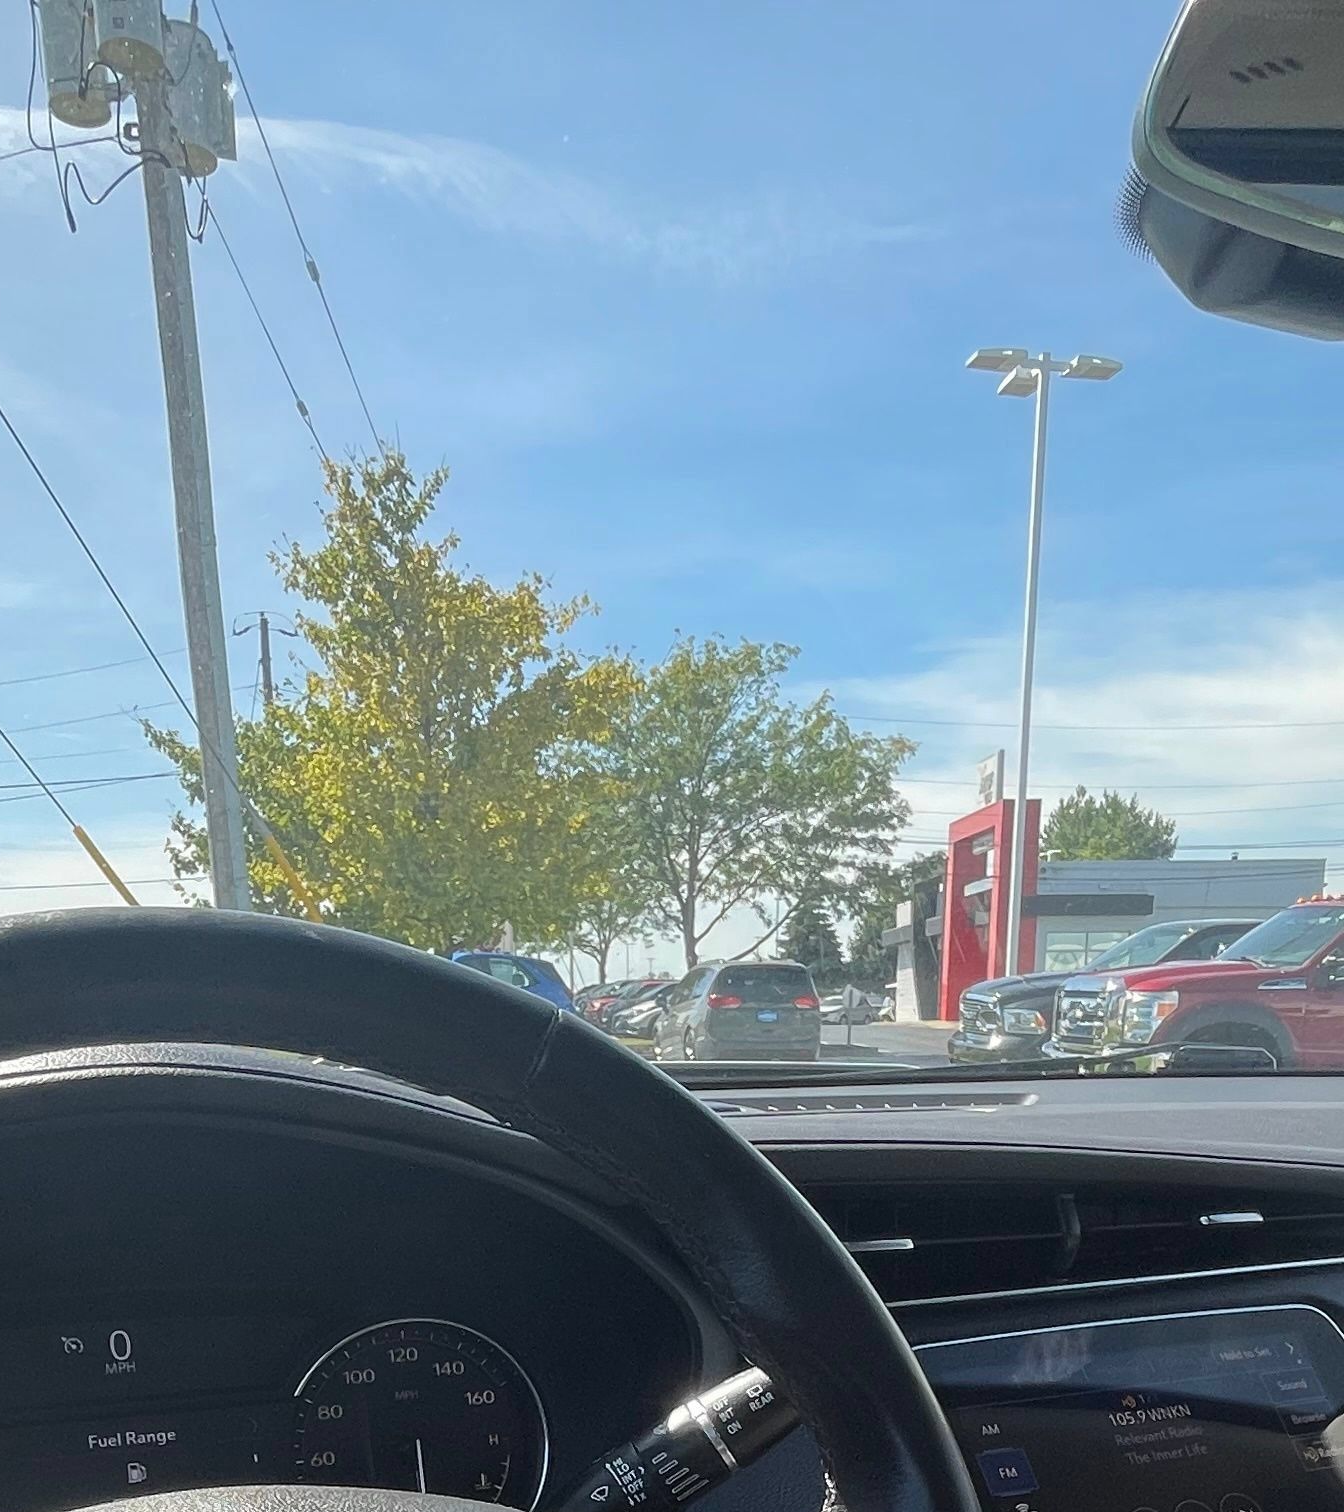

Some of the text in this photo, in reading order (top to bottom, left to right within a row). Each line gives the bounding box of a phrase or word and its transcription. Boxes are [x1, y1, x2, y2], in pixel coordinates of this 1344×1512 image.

[109, 1329, 132, 1361] 0
[387, 1346, 419, 1363] 120
[105, 1360, 137, 1375] MPH
[432, 1360, 465, 1377] 140
[342, 1369, 376, 1386] 100
[464, 1390, 496, 1407] 160
[712, 1396, 729, 1412] OFF
[748, 1392, 775, 1412] REAR
[317, 1404, 344, 1421] 80
[718, 1407, 735, 1423] INT
[1108, 1404, 1192, 1427] 105.9 WNKN
[726, 1420, 743, 1435] ON
[982, 1424, 1000, 1436] AM
[88, 1428, 177, 1450] Fuel Range
[310, 1451, 336, 1468] 60
[1124, 1451, 1151, 1465] The
[616, 1463, 630, 1476] LO
[621, 1469, 637, 1485] INT
[998, 1467, 1019, 1480] FM
[627, 1478, 644, 1494] OFF
